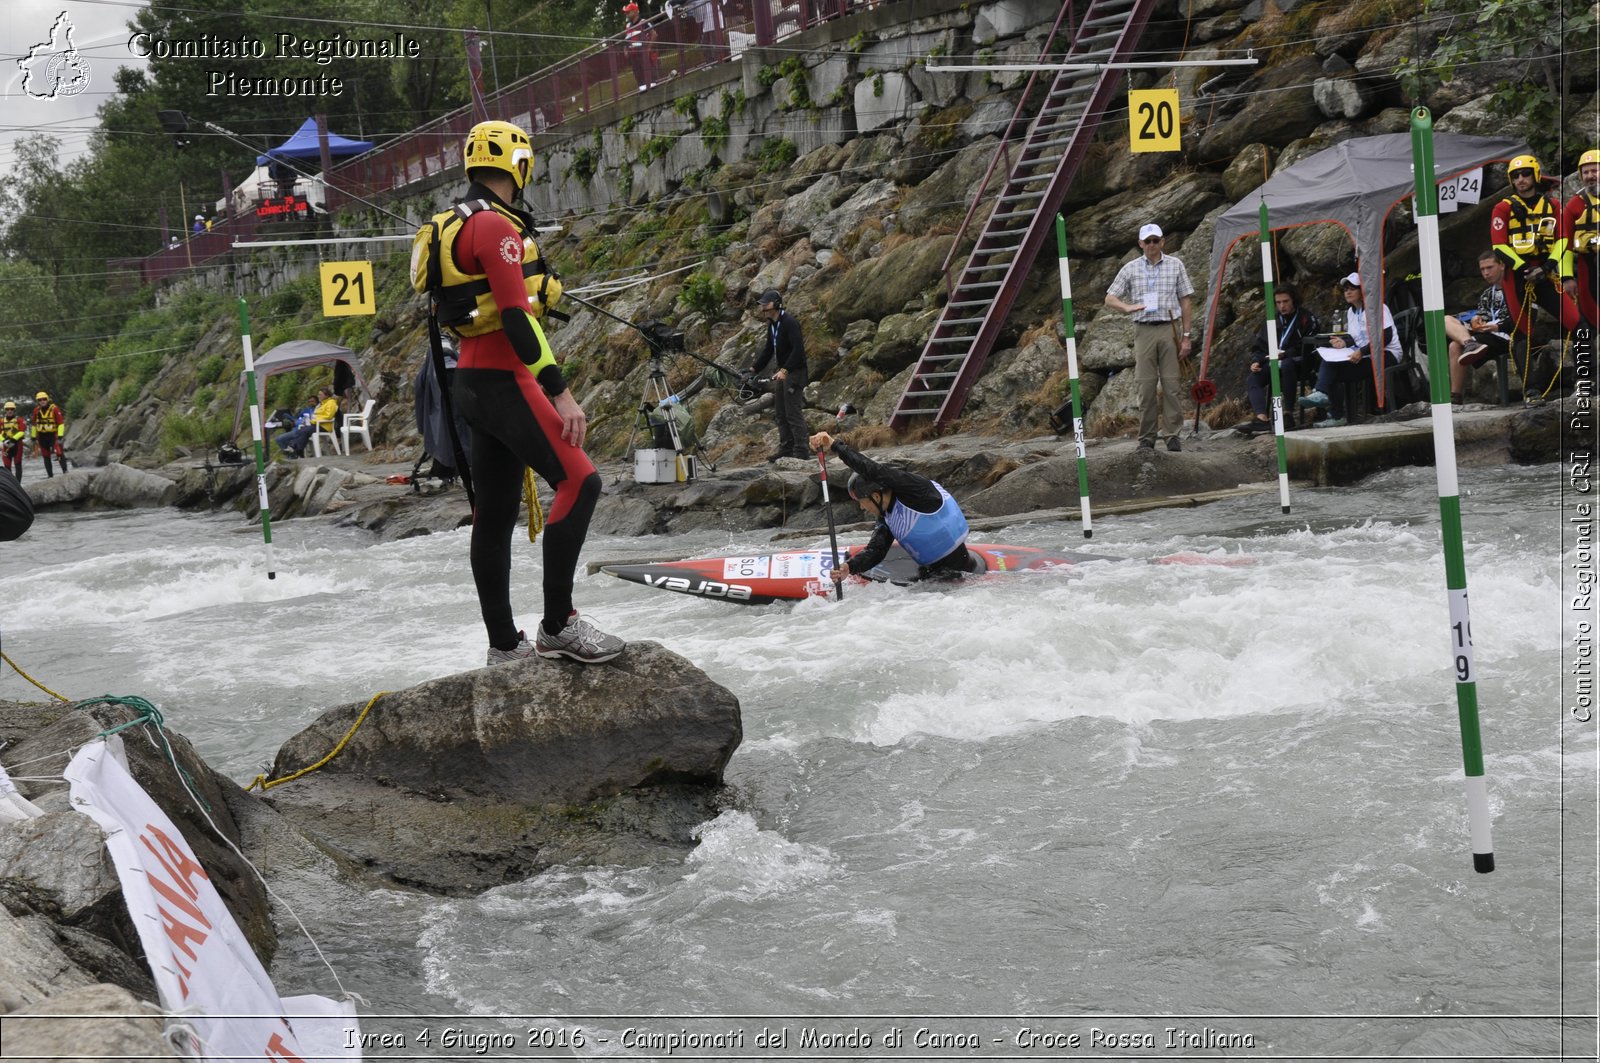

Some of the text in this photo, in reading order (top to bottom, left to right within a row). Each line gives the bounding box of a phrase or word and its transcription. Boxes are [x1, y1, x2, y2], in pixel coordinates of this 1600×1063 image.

[1138, 101, 1173, 139] 20
[1441, 185, 1456, 200] 23
[1461, 177, 1479, 192] 24
[331, 271, 366, 306] 21
[740, 558, 755, 576] SLO
[1456, 654, 1469, 681] 9
